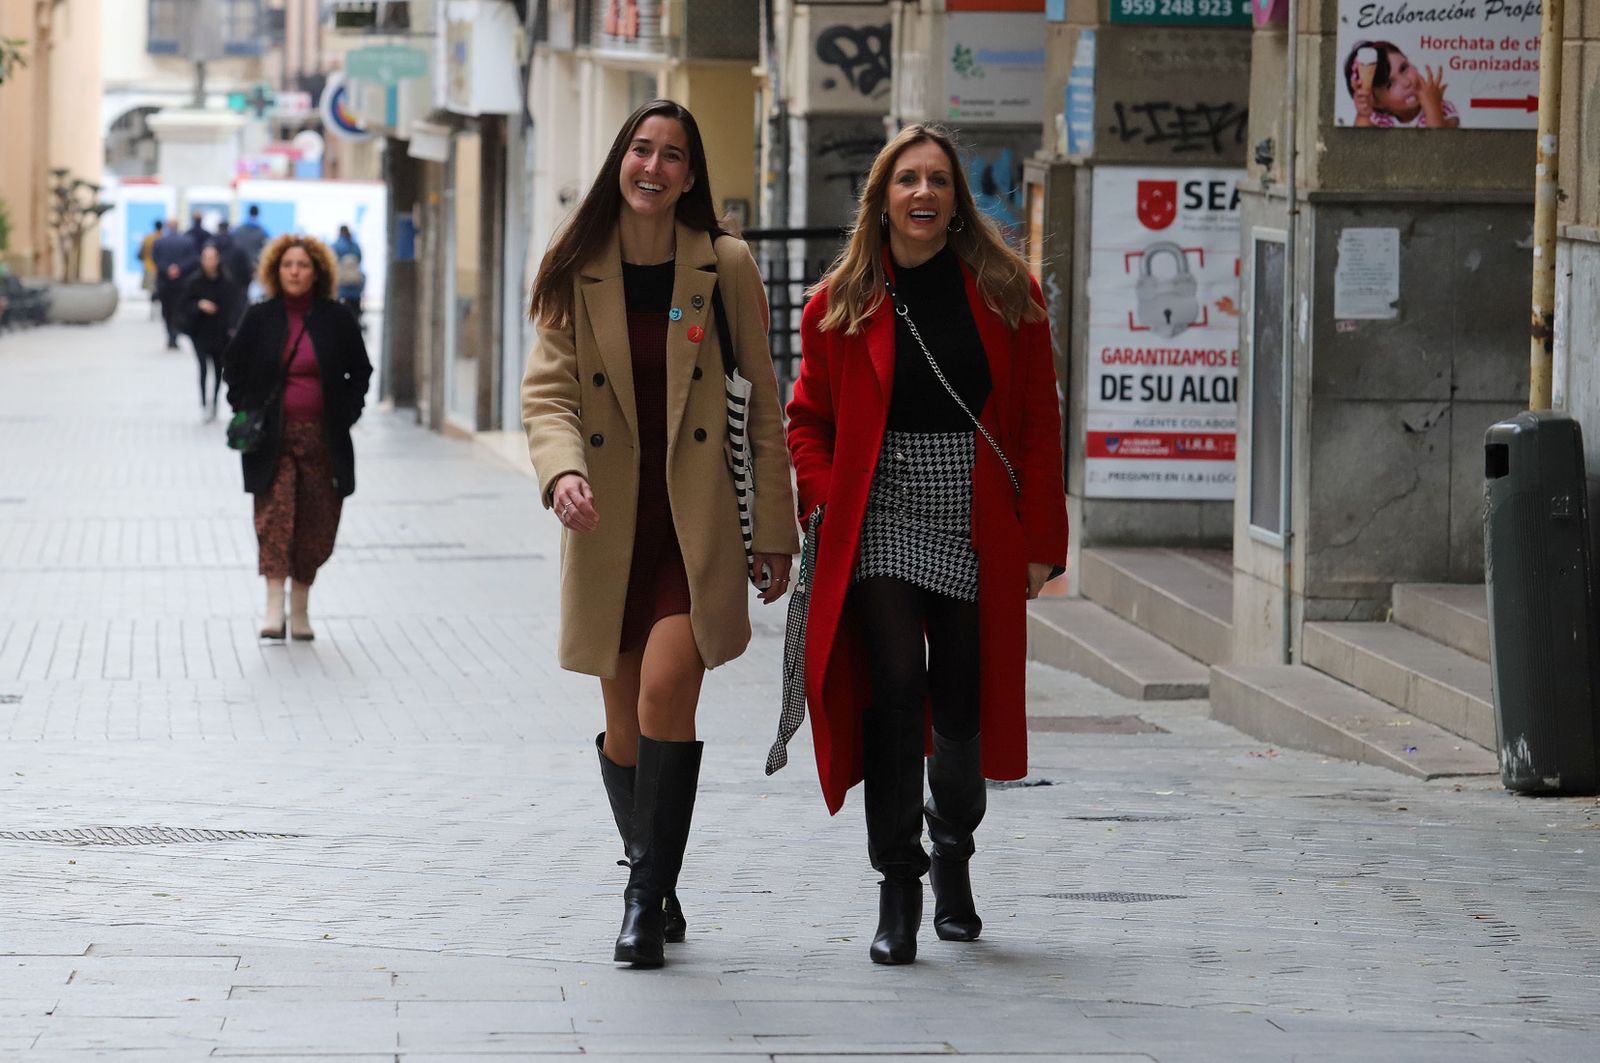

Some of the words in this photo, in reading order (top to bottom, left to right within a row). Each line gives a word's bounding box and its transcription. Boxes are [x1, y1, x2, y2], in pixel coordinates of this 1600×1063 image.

[1121, 0, 1156, 15] 959
[1160, 0, 1194, 15] 248
[1199, 0, 1233, 16] 923
[1357, 0, 1476, 28] Elaboración
[1420, 35, 1495, 51] Horchata
[1500, 35, 1520, 51] de
[1449, 55, 1540, 72] Granizadas
[1101, 347, 1227, 367] GARANTIZAMOS
[1101, 374, 1134, 402] DE
[1140, 375, 1173, 403] SU
[1134, 417, 1177, 428] AGENTE
